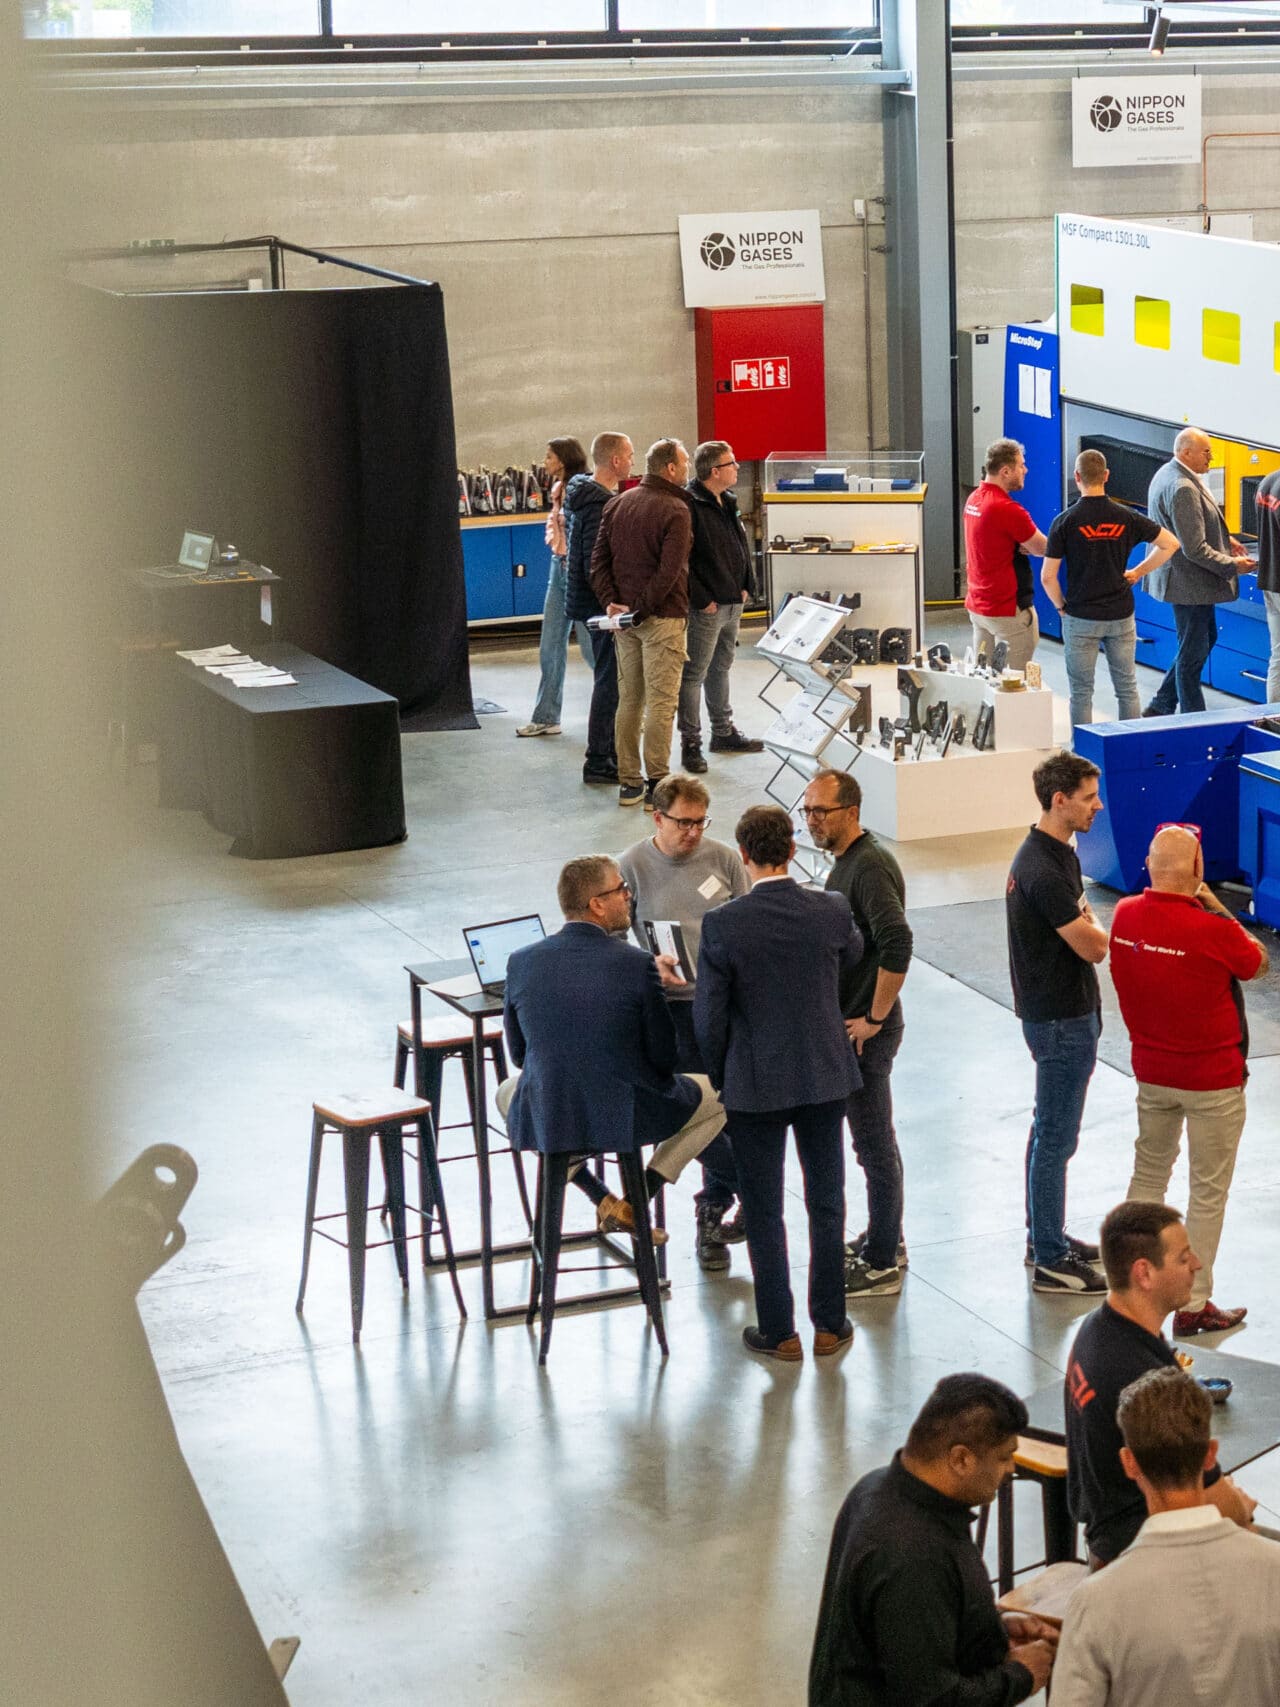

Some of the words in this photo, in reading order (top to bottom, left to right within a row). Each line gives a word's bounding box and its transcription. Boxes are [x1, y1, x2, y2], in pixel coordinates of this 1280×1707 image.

[1126, 95, 1185, 109] NIPPON
[1126, 111, 1175, 124] GASES
[739, 231, 803, 246] NIPPON
[1062, 222, 1077, 236] MSF
[1080, 224, 1113, 242] Compact
[1115, 230, 1151, 249] 1501.30L
[740, 247, 793, 262] GASES
[1010, 332, 1044, 350] MicroStep
